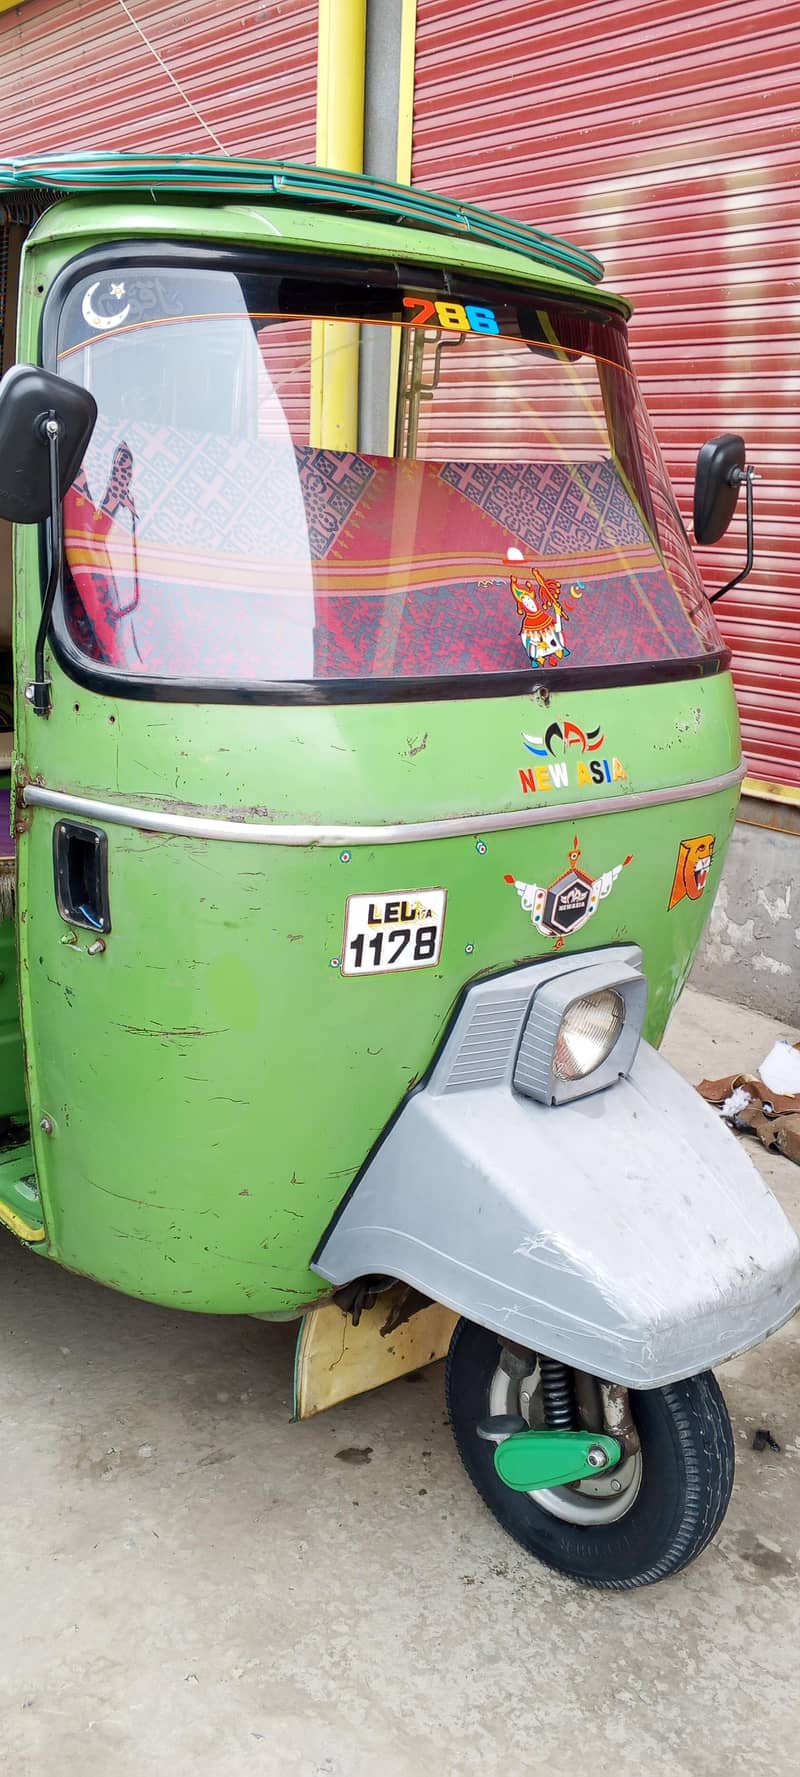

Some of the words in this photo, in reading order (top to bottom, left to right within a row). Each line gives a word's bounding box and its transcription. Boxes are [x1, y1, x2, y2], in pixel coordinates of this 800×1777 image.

[402, 297, 500, 335] 786
[518, 762, 569, 794] NEW
[577, 757, 628, 788] ASIA
[350, 925, 437, 967] 1178
